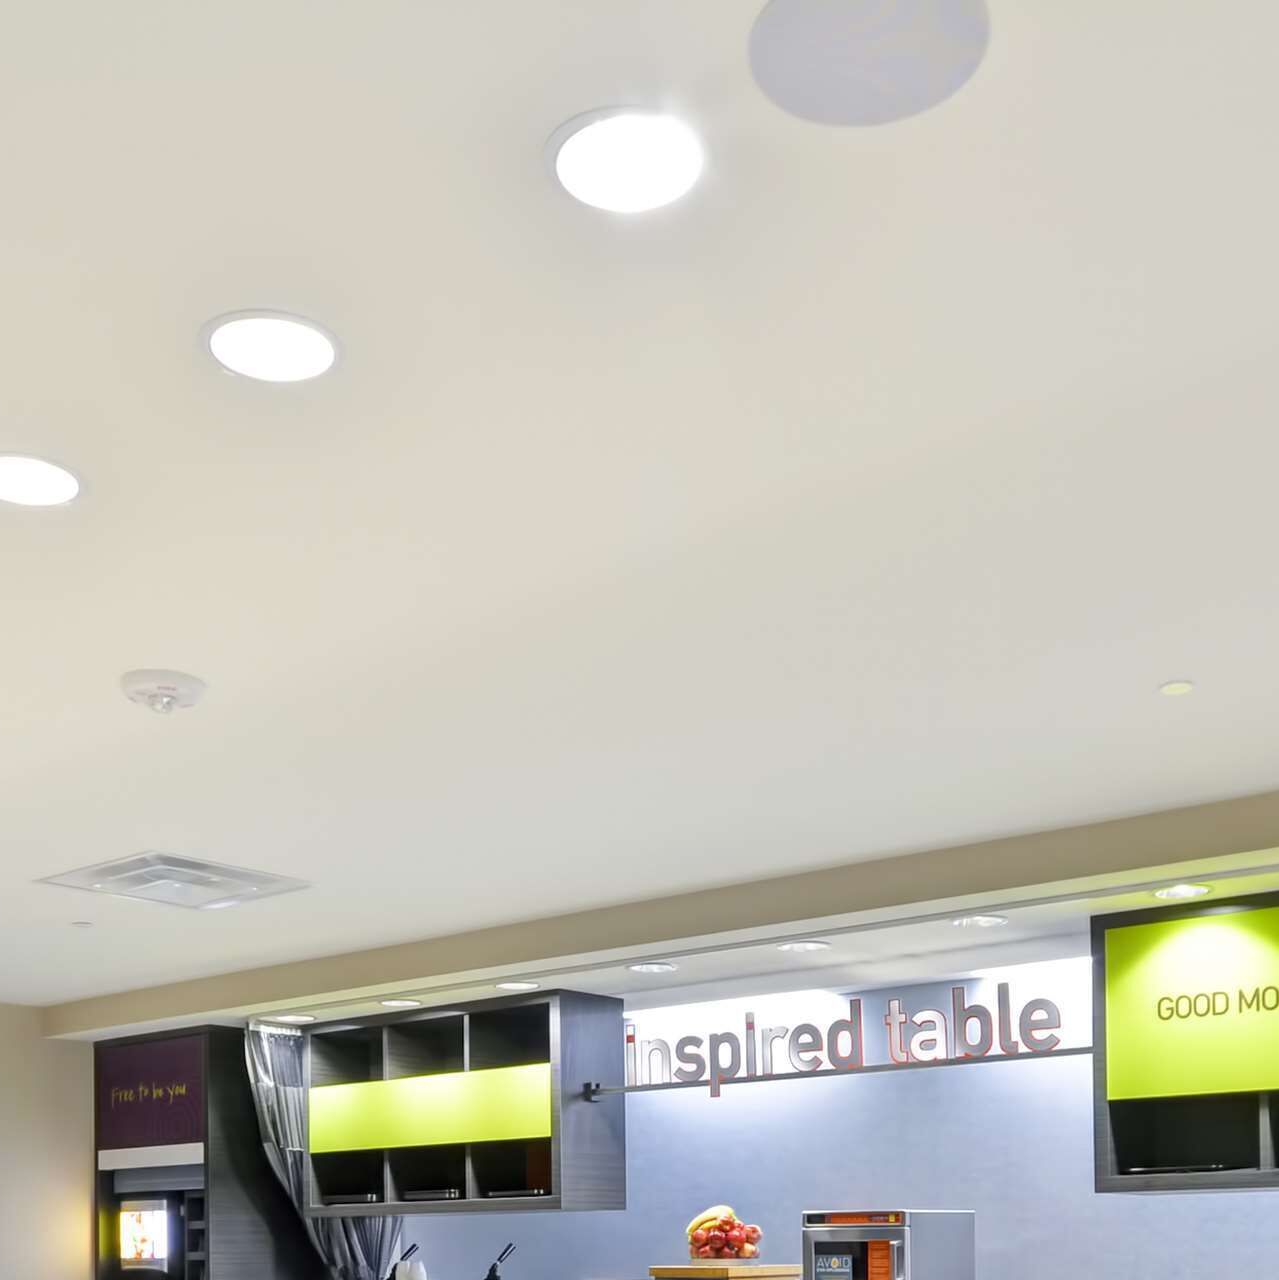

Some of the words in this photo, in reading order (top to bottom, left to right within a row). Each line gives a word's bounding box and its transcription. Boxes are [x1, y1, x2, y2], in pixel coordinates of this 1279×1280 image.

[1156, 989, 1229, 1021] GOOD
[625, 999, 864, 1097] inspired
[884, 982, 1061, 1065] table
[166, 1083, 187, 1104] you
[817, 1257, 850, 1268] AVOID
